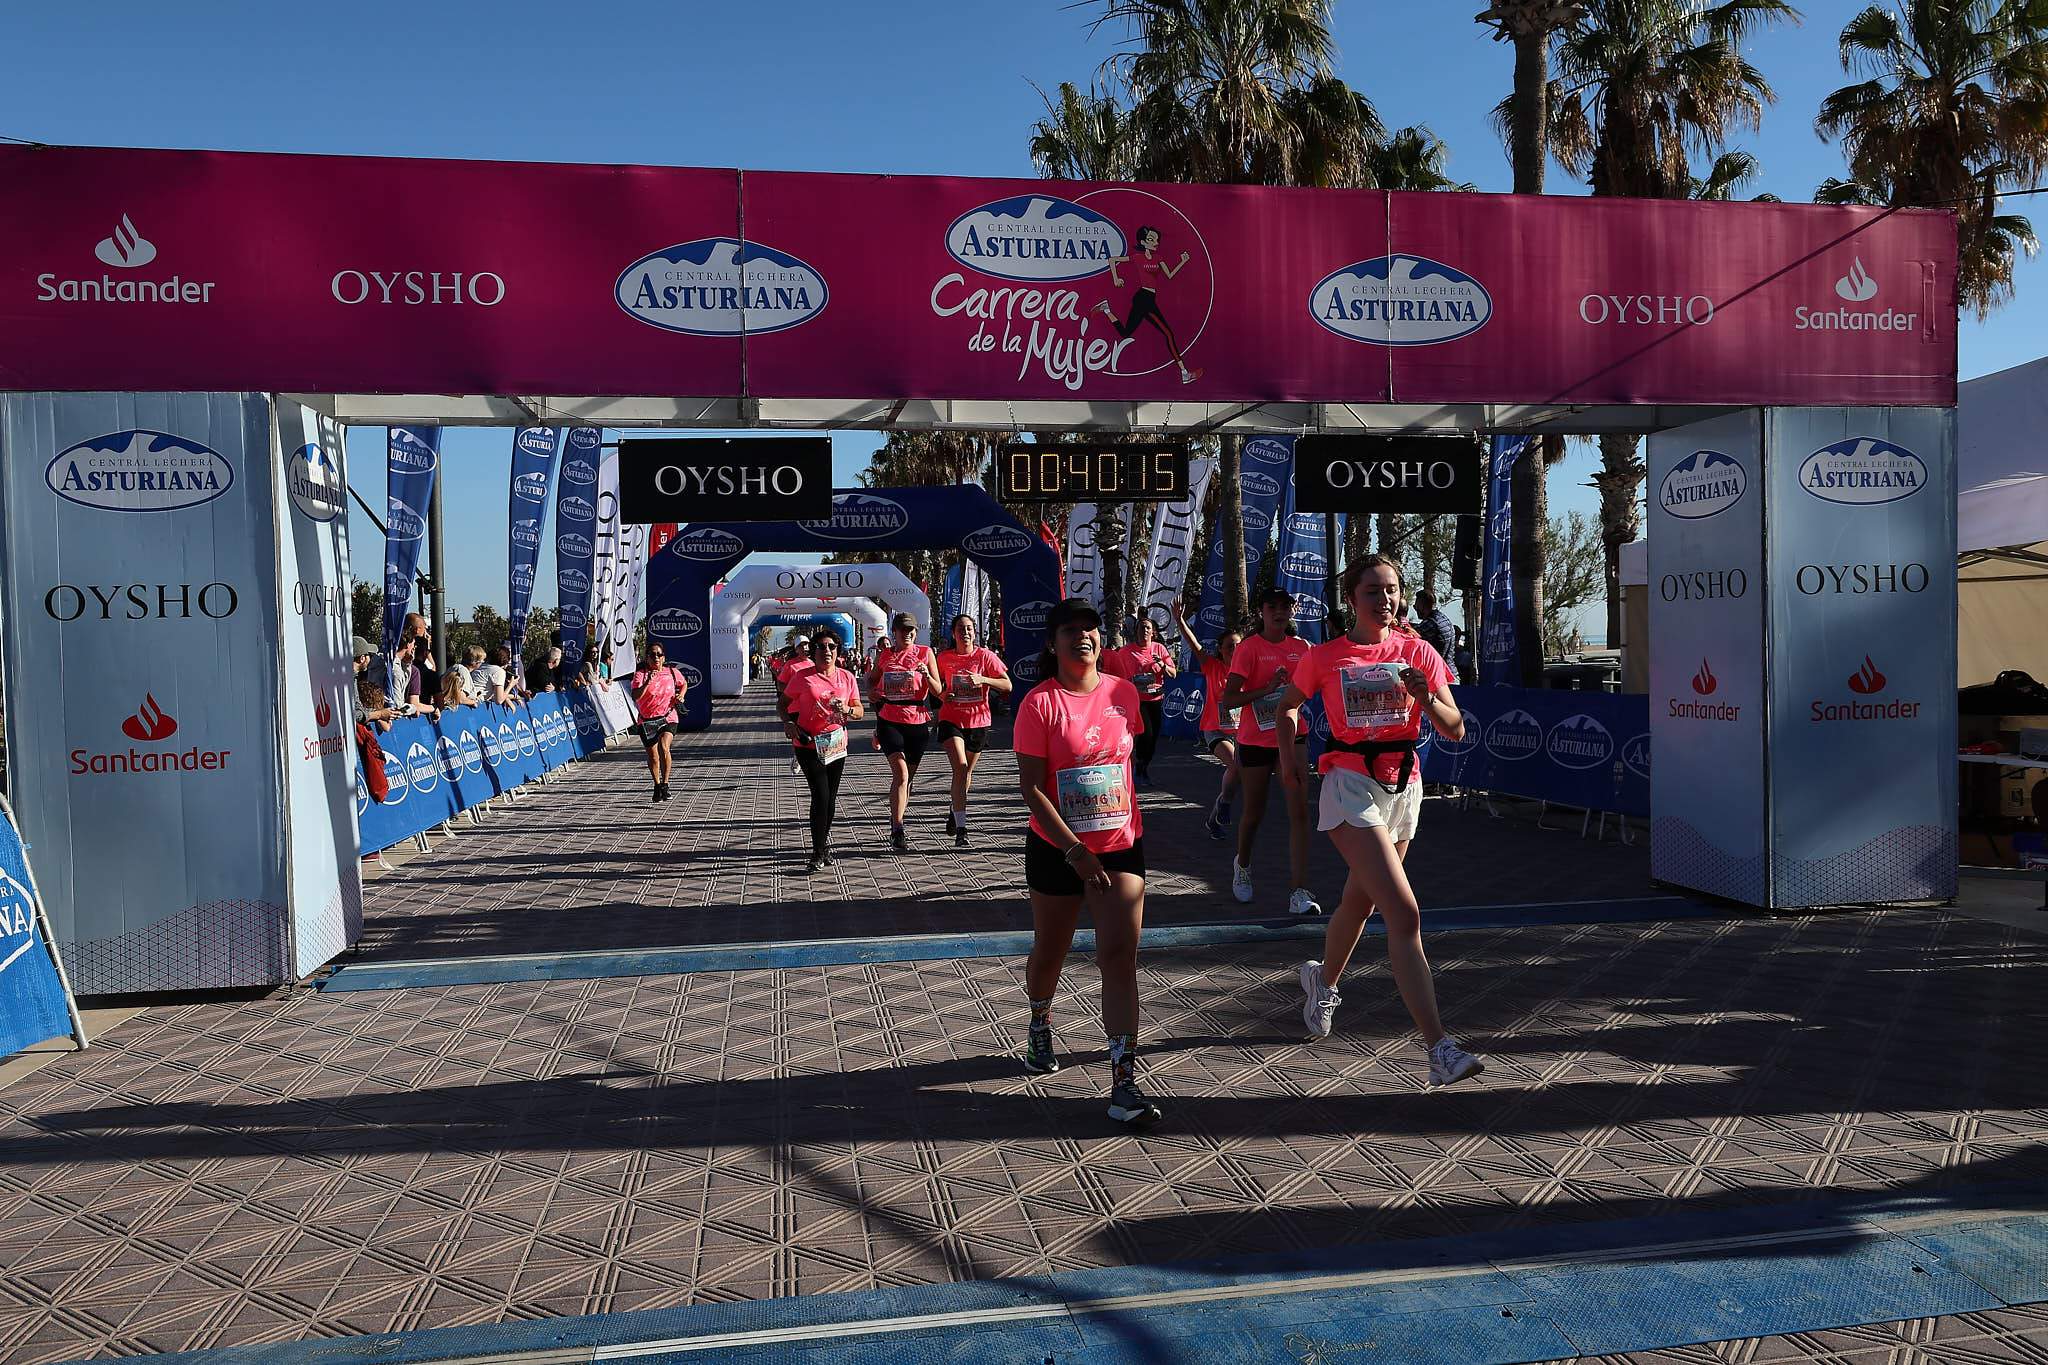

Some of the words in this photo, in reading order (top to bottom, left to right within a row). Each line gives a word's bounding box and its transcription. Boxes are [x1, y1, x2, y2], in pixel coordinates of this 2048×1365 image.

[960, 225, 1112, 260] ASTURIANA
[988, 223, 1045, 233] CENTRAL
[1050, 225, 1108, 235] LECHERA
[37, 273, 215, 303] Santander
[331, 270, 506, 306] OYSHO
[665, 271, 731, 281] CENTRAL
[632, 273, 813, 310] ASTURIANA
[931, 273, 1080, 320] Carrera
[1324, 287, 1478, 322] ASTURIANA
[1352, 285, 1409, 295] CENTRAL
[1414, 286, 1472, 296] LECHERA
[1579, 294, 1714, 326] OYSHO
[1795, 307, 1917, 331] Santander
[968, 321, 996, 352] de
[1002, 320, 1021, 353] la
[1018, 316, 1135, 390] Mujer
[89, 458, 148, 467] CENTRAL
[154, 458, 214, 467] LECHERA
[390, 448, 430, 468] URIANA
[61, 460, 221, 491] ASTURIANA
[654, 465, 803, 496] OYSHO
[1011, 453, 1175, 492] 00:40:15
[1326, 460, 1455, 489] OYSHO
[1807, 463, 1918, 488] ASTURIANA
[1665, 478, 1740, 506] ASTURIANA
[677, 540, 738, 553] ASTURIANA
[966, 535, 1028, 550] ASTURIANA
[776, 571, 864, 589] OYSHO
[1661, 568, 1747, 601] OYSHO
[1796, 563, 1929, 595] OYSHO
[44, 582, 238, 621] OYSHO
[293, 581, 346, 619] OYSHO
[650, 618, 699, 631] ASTURIANA
[1669, 698, 1740, 721] Santander
[1811, 701, 1921, 721] Santander
[304, 733, 347, 760] Santander
[1550, 731, 1605, 757] ASTURIANA
[71, 747, 231, 775] Santander
